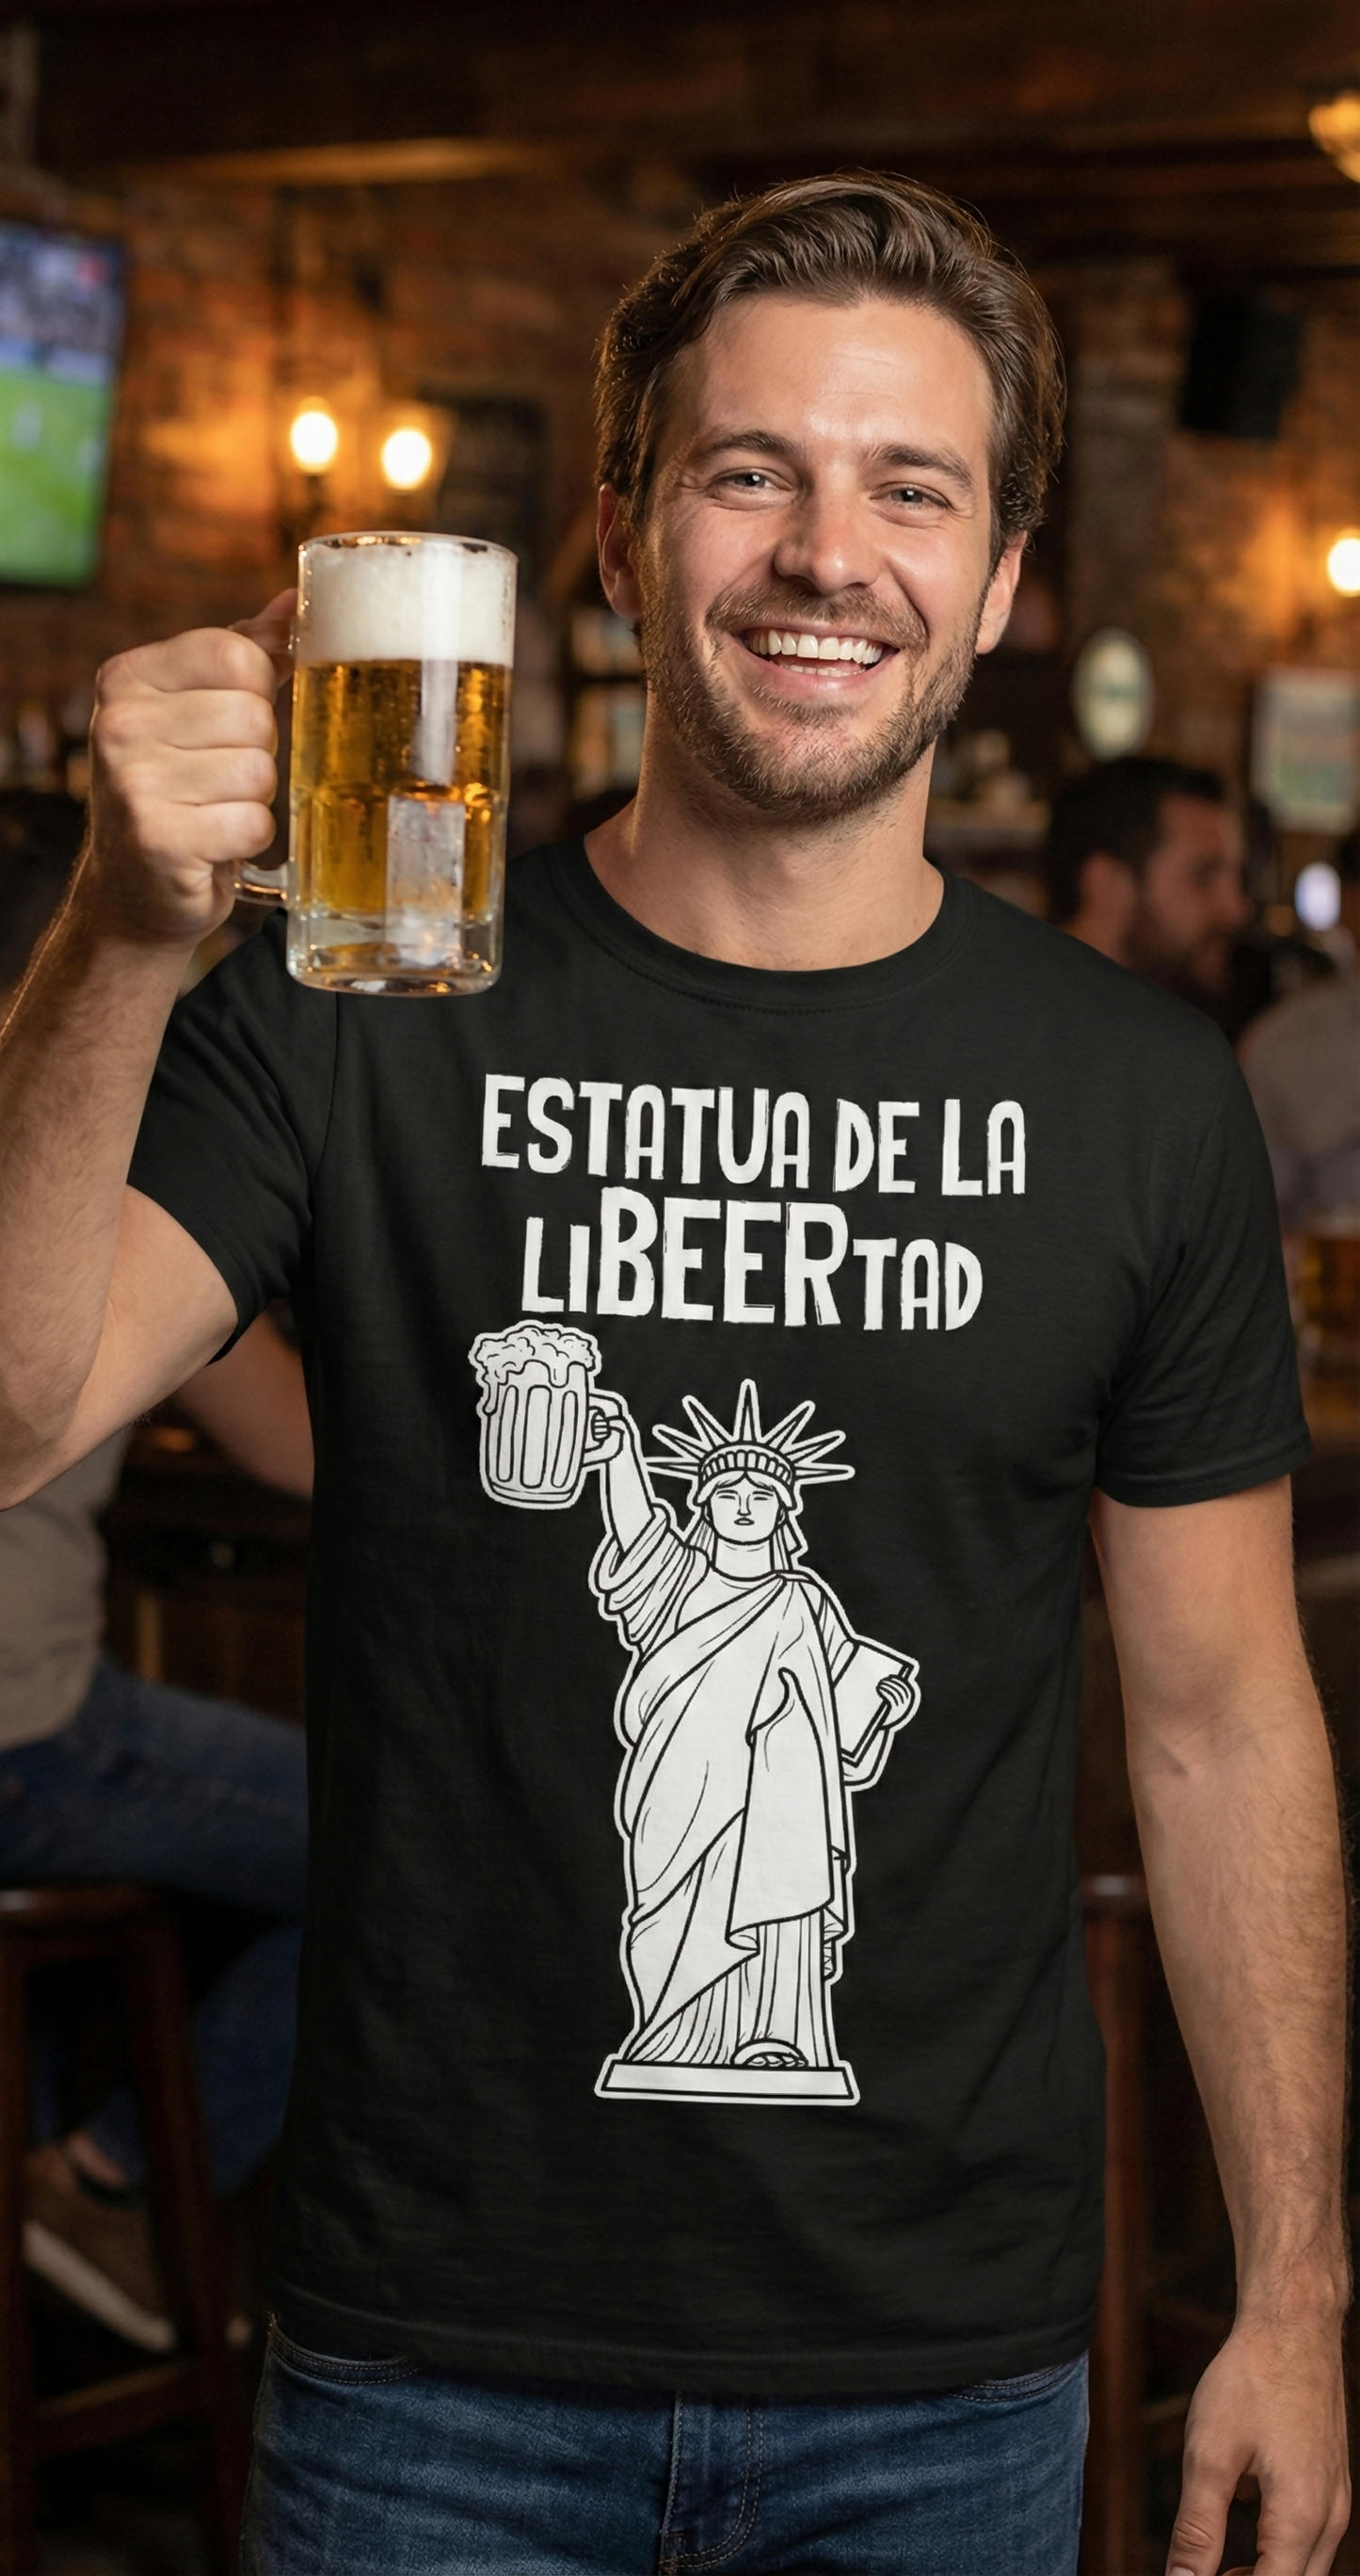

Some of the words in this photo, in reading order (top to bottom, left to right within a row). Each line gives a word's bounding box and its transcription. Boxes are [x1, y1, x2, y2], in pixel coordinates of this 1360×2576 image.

[481, 1073, 809, 1188] ESTATUA
[833, 1098, 920, 1193] DE
[941, 1098, 1026, 1196] LA
[520, 1186, 984, 1331] LIBEERTAD
